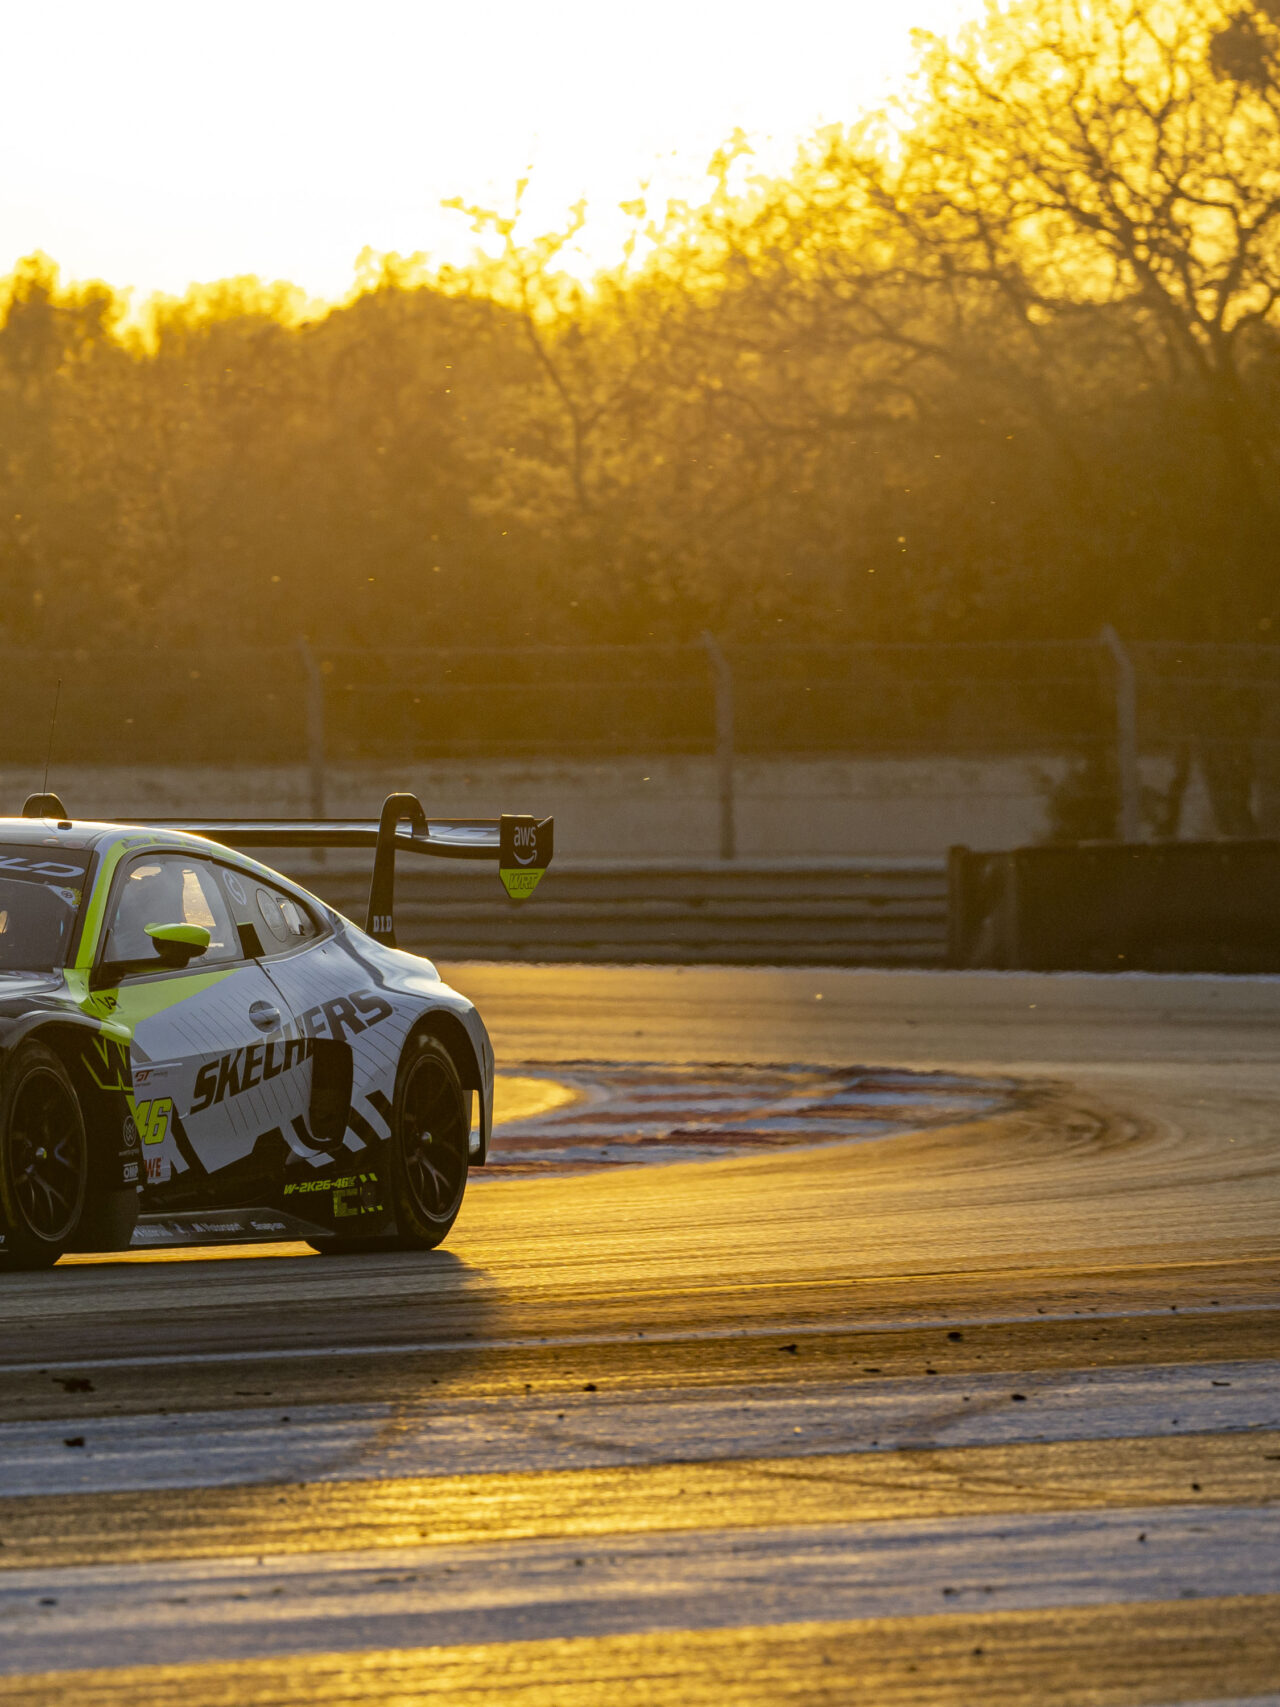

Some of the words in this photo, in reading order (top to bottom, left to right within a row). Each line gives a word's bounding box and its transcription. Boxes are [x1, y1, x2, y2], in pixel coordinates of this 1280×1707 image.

[513, 827, 536, 847] aws
[509, 873, 539, 890] WRT
[190, 989, 394, 1116] SKECHERS
[130, 1096, 172, 1145] 46
[144, 1157, 162, 1178] WE
